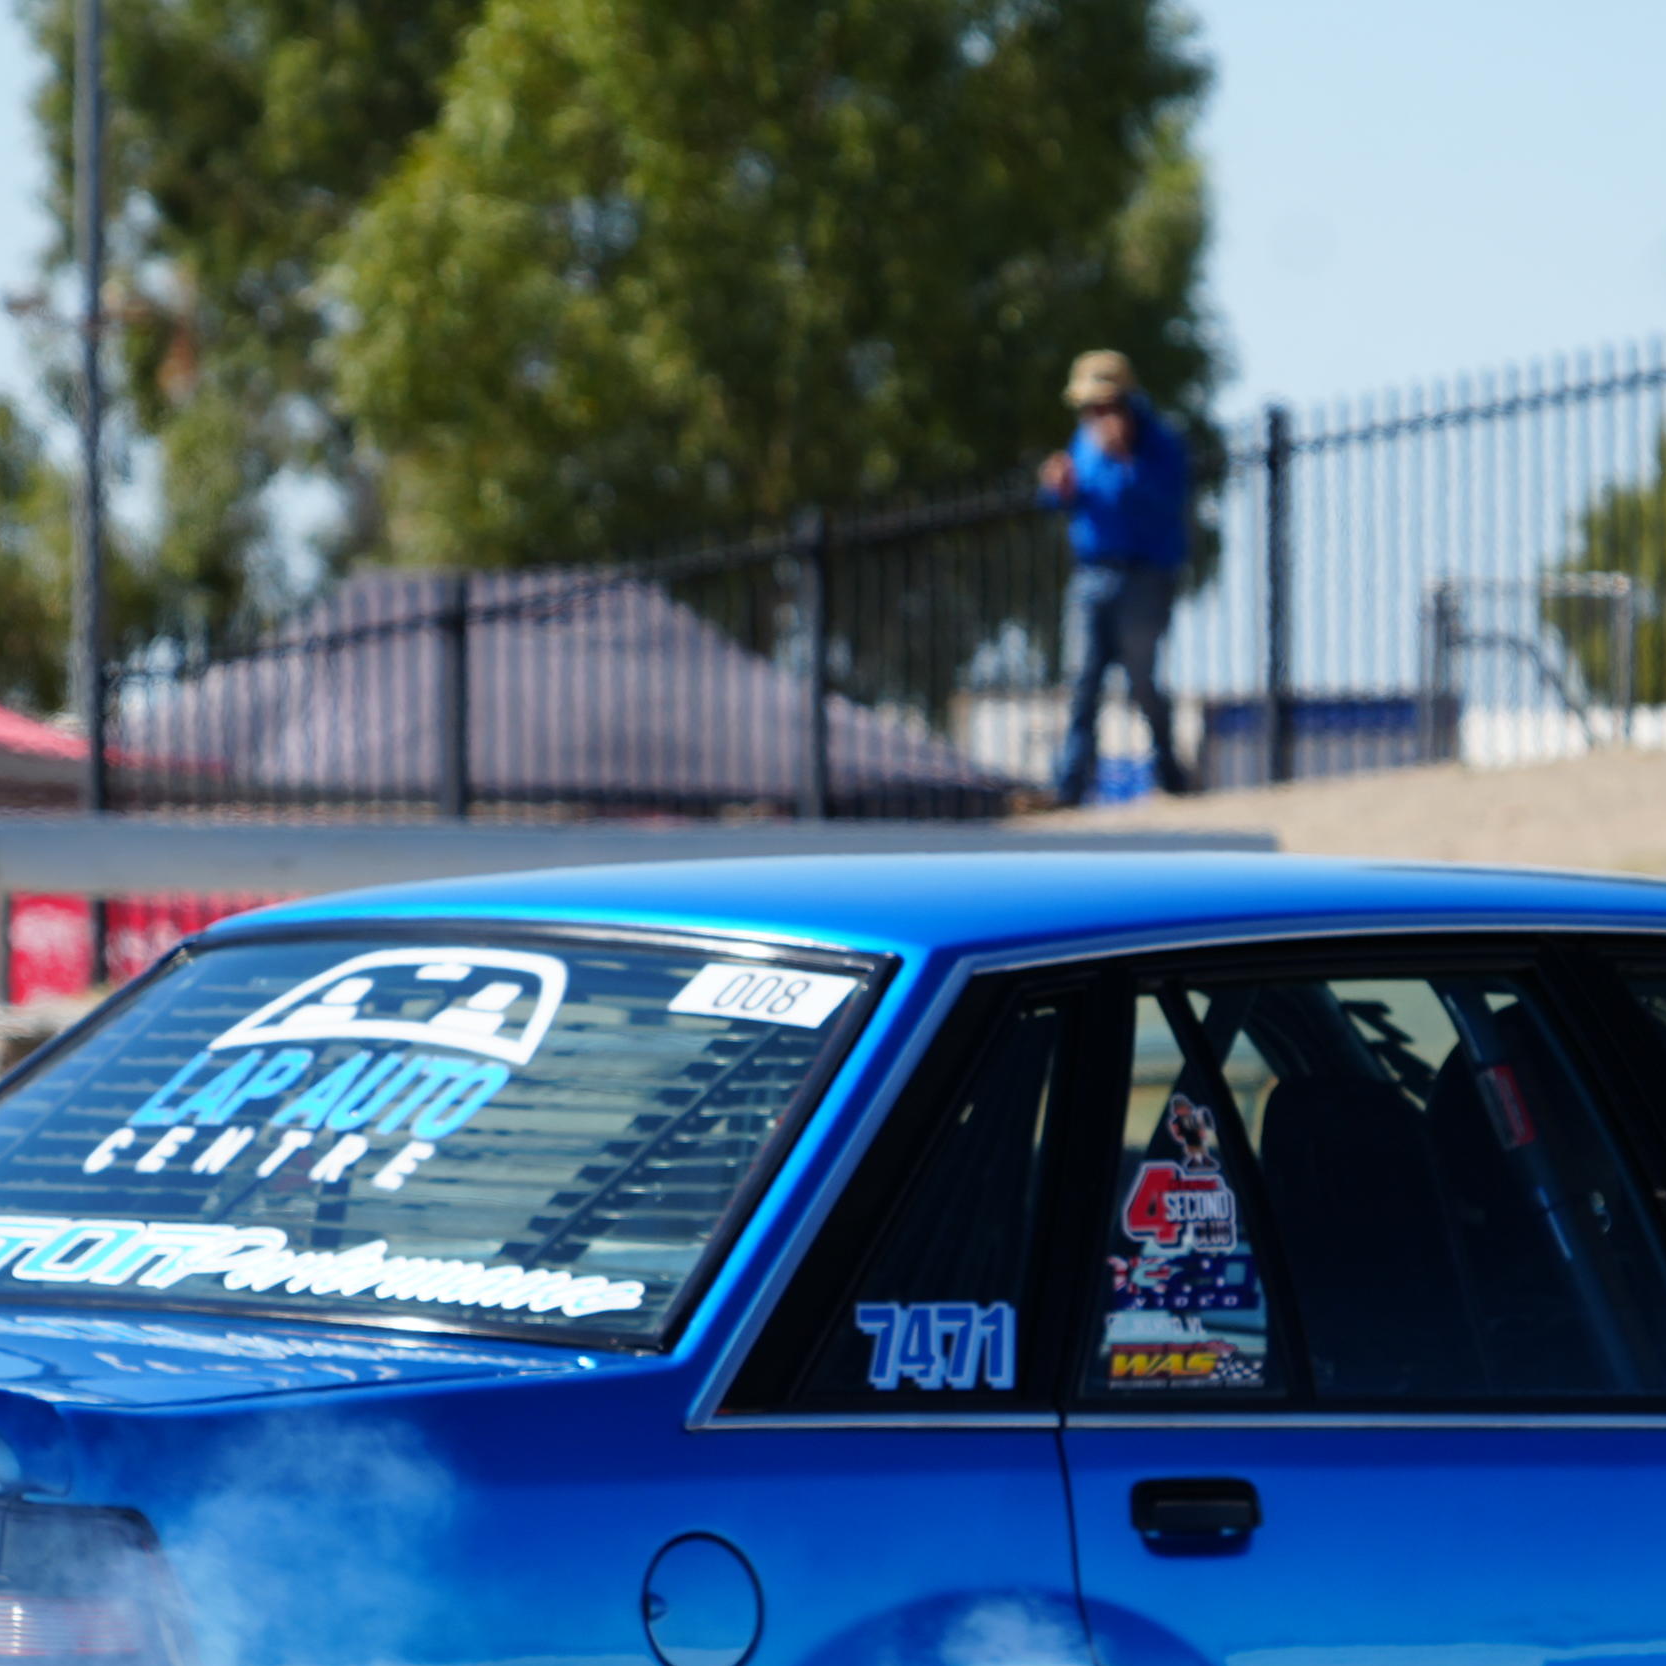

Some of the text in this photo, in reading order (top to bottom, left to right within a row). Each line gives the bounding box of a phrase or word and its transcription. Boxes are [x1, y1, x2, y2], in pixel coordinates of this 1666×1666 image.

[712, 973, 812, 1015] 008
[126, 1048, 511, 1140] LAP AUTO
[82, 1126, 436, 1191] CENTRE
[1164, 1190, 1231, 1221] SECOND
[856, 1302, 1016, 1390] 7471
[1110, 1352, 1219, 1378] WAS
